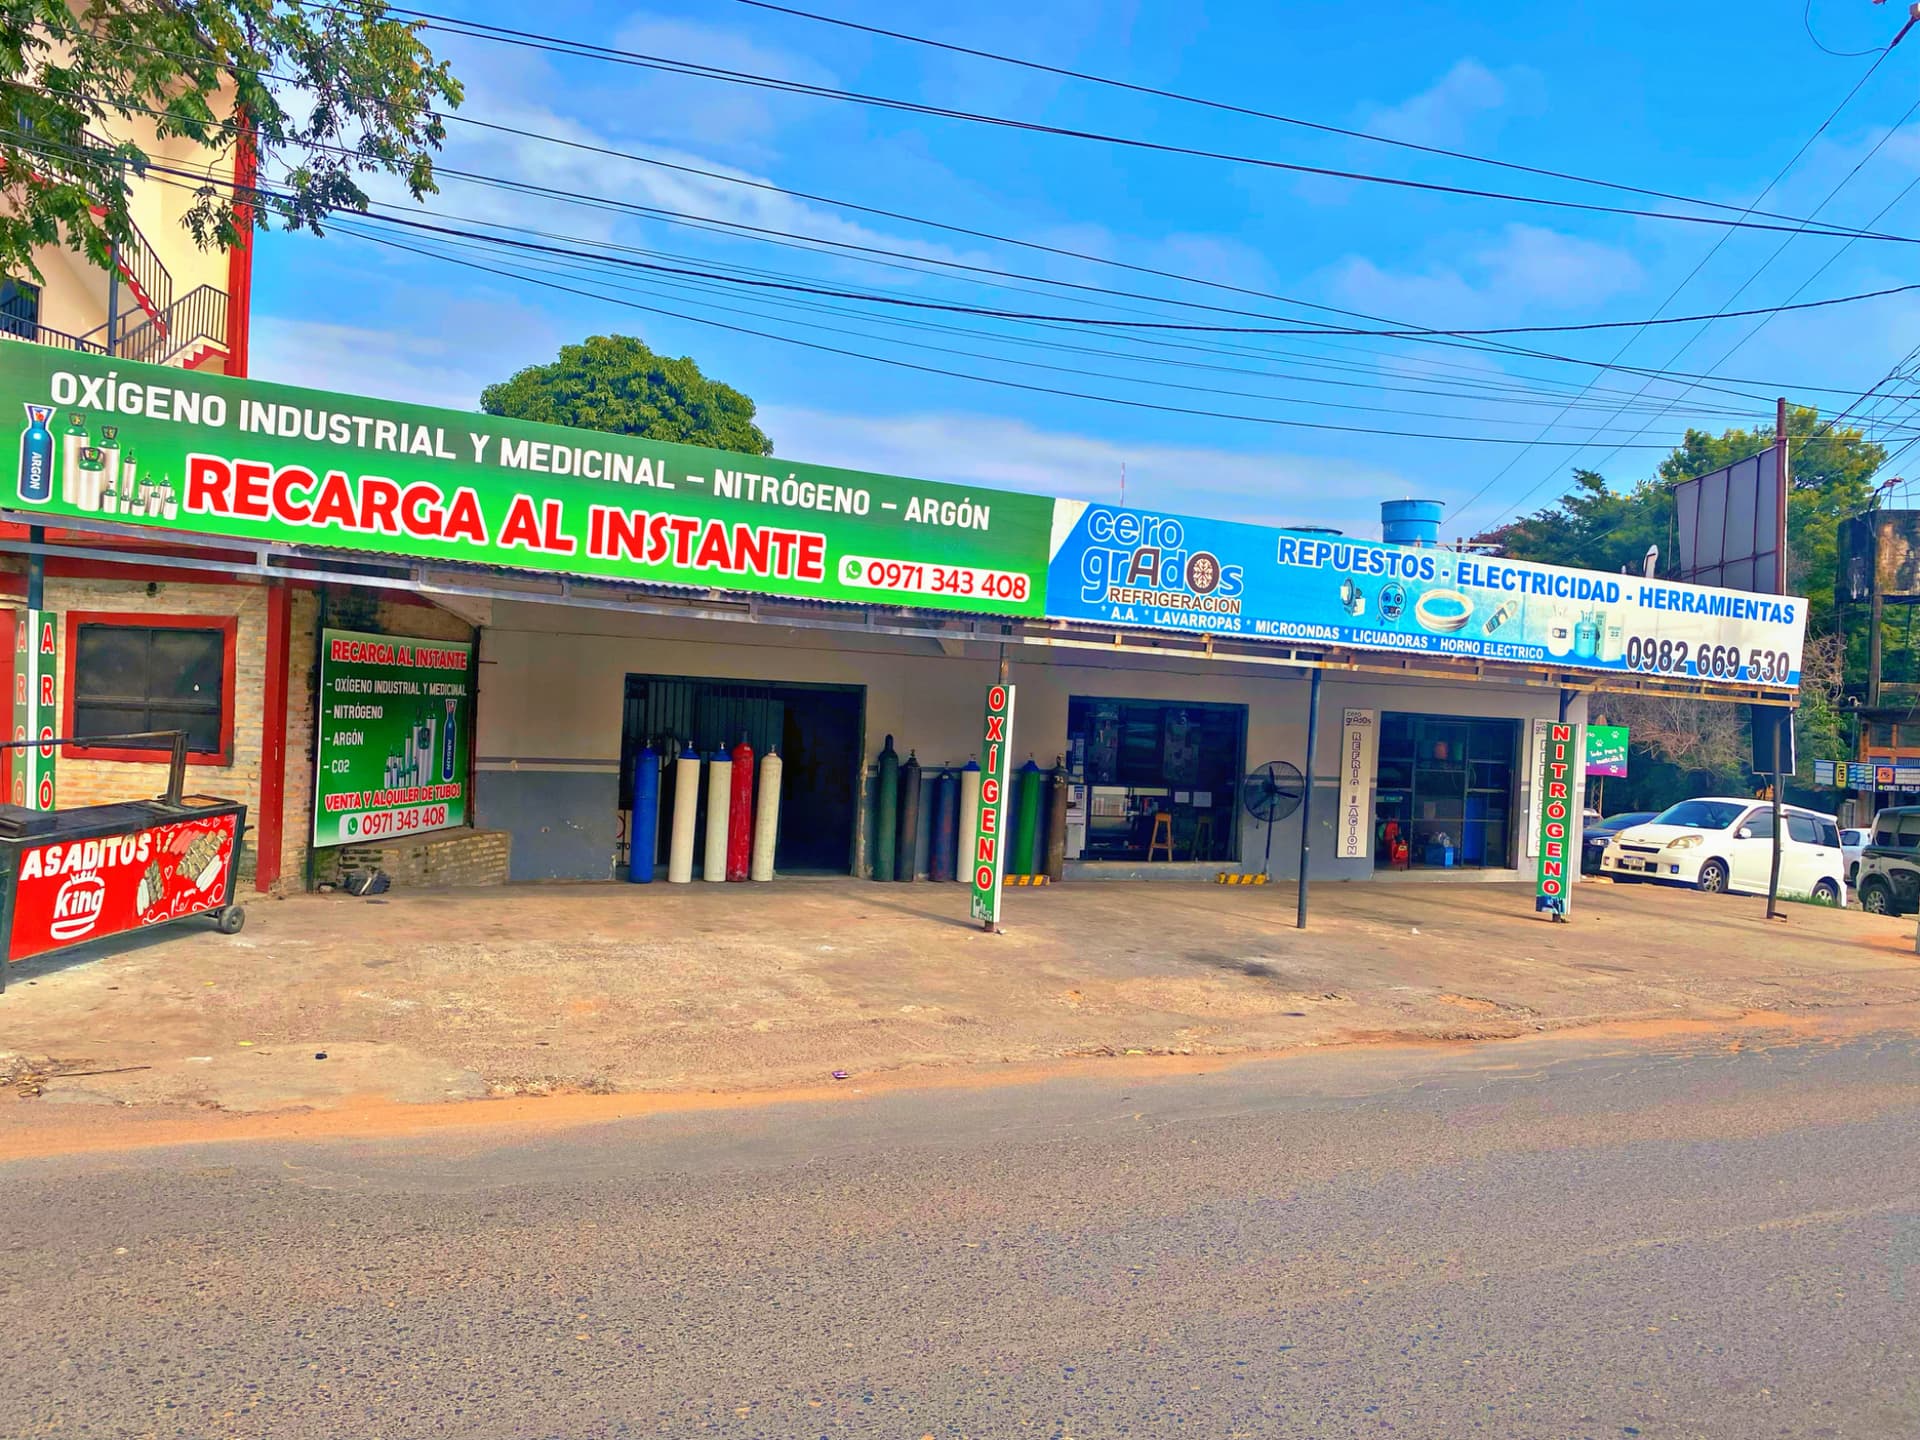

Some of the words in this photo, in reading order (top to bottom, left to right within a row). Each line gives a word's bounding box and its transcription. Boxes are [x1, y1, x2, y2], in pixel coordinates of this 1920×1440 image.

[50, 370, 227, 428] OXÍGENO
[240, 399, 456, 460] INDUSTRIAL
[470, 433, 490, 463] Y
[501, 438, 675, 490] MEDICINAL
[714, 468, 871, 516] NITRÓGENO
[904, 496, 990, 531] ARGÓN
[29, 451, 42, 490] ARGON
[185, 454, 487, 543] RECARGA
[501, 495, 577, 554] AL
[588, 506, 825, 582] INSTANTE
[1088, 509, 1184, 549] cero
[867, 561, 923, 589] 0971
[932, 567, 974, 594] 343
[982, 573, 1027, 600] 408
[1278, 536, 1435, 581] REPUESTOS
[1457, 562, 1620, 604] ELECTRICIDAD
[1639, 587, 1794, 625] HERRAMIENTAS
[1108, 587, 1241, 614] REFRIGERACION
[1154, 610, 1241, 631] LAVARROPAS
[1255, 620, 1340, 640] MICROONDAS
[1353, 629, 1428, 649] LICUADORAS
[1440, 639, 1480, 655] HORNO
[1483, 643, 1544, 660] ELECTRICO
[331, 640, 394, 665] RECARGA
[397, 646, 413, 666] AL
[416, 649, 467, 670] INSTANTE
[1626, 636, 1688, 673] 0982
[1696, 643, 1741, 679] 669
[1747, 648, 1790, 684] 530
[335, 676, 372, 692] OXÍGENO
[374, 680, 420, 695] INDUSTRIAL
[423, 683, 428, 695] Y
[429, 683, 467, 696] MEDICINAL
[334, 702, 383, 719] NITRÓGENO
[333, 730, 364, 746] ARGÓN
[331, 760, 350, 774] CO2
[325, 792, 361, 812] VENTA
[364, 791, 371, 807] Y
[372, 787, 419, 808] ALQUILER
[422, 787, 432, 801] DE
[435, 783, 461, 799] TUBOS
[976, 687, 1006, 889] OXÍGENO
[362, 812, 392, 835] 0971
[396, 810, 419, 831] 343
[422, 806, 445, 826] 408
[1542, 725, 1570, 895] NITRÓGENO
[20, 832, 152, 881] ASADITOS
[53, 885, 105, 921] king
